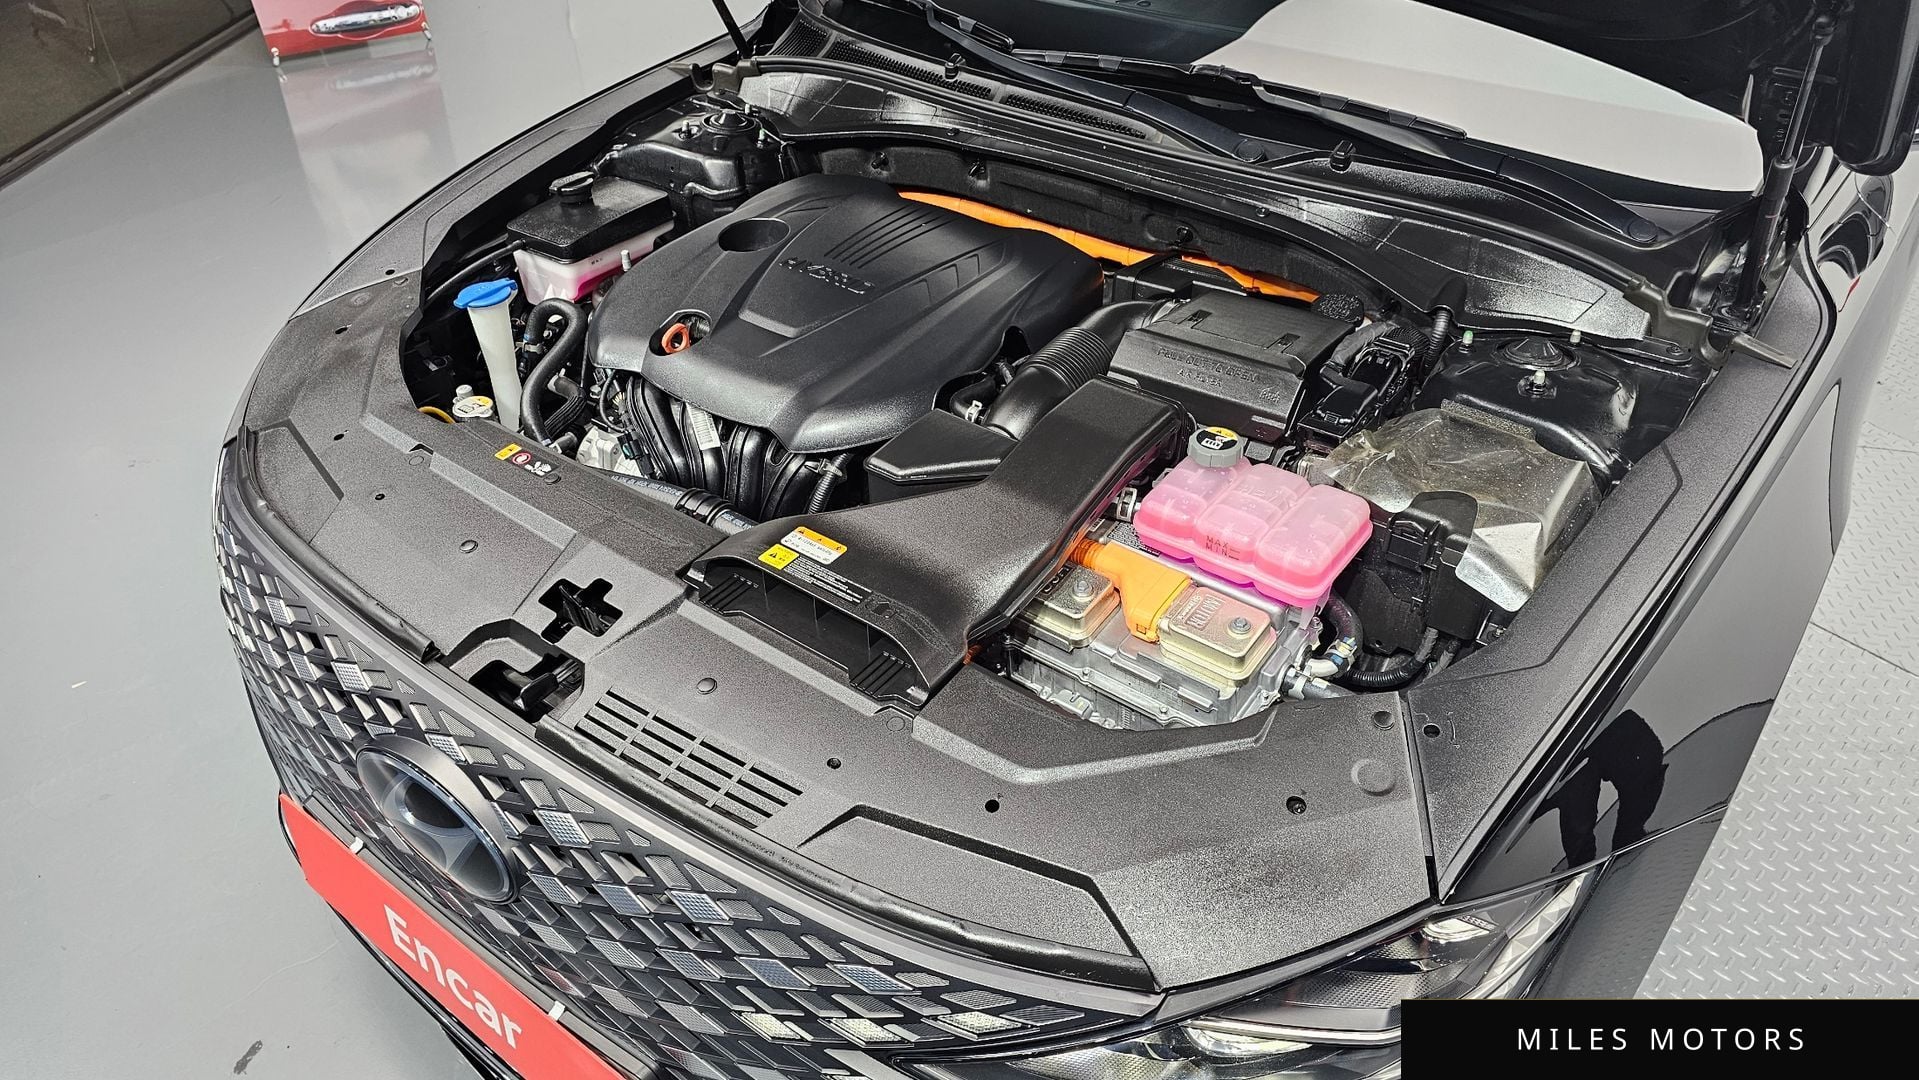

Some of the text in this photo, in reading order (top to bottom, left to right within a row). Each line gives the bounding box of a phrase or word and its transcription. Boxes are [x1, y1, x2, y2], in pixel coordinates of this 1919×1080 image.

[1205, 543, 1228, 557] MIN
[1206, 535, 1229, 551] MAX
[384, 904, 522, 1049] Encar
